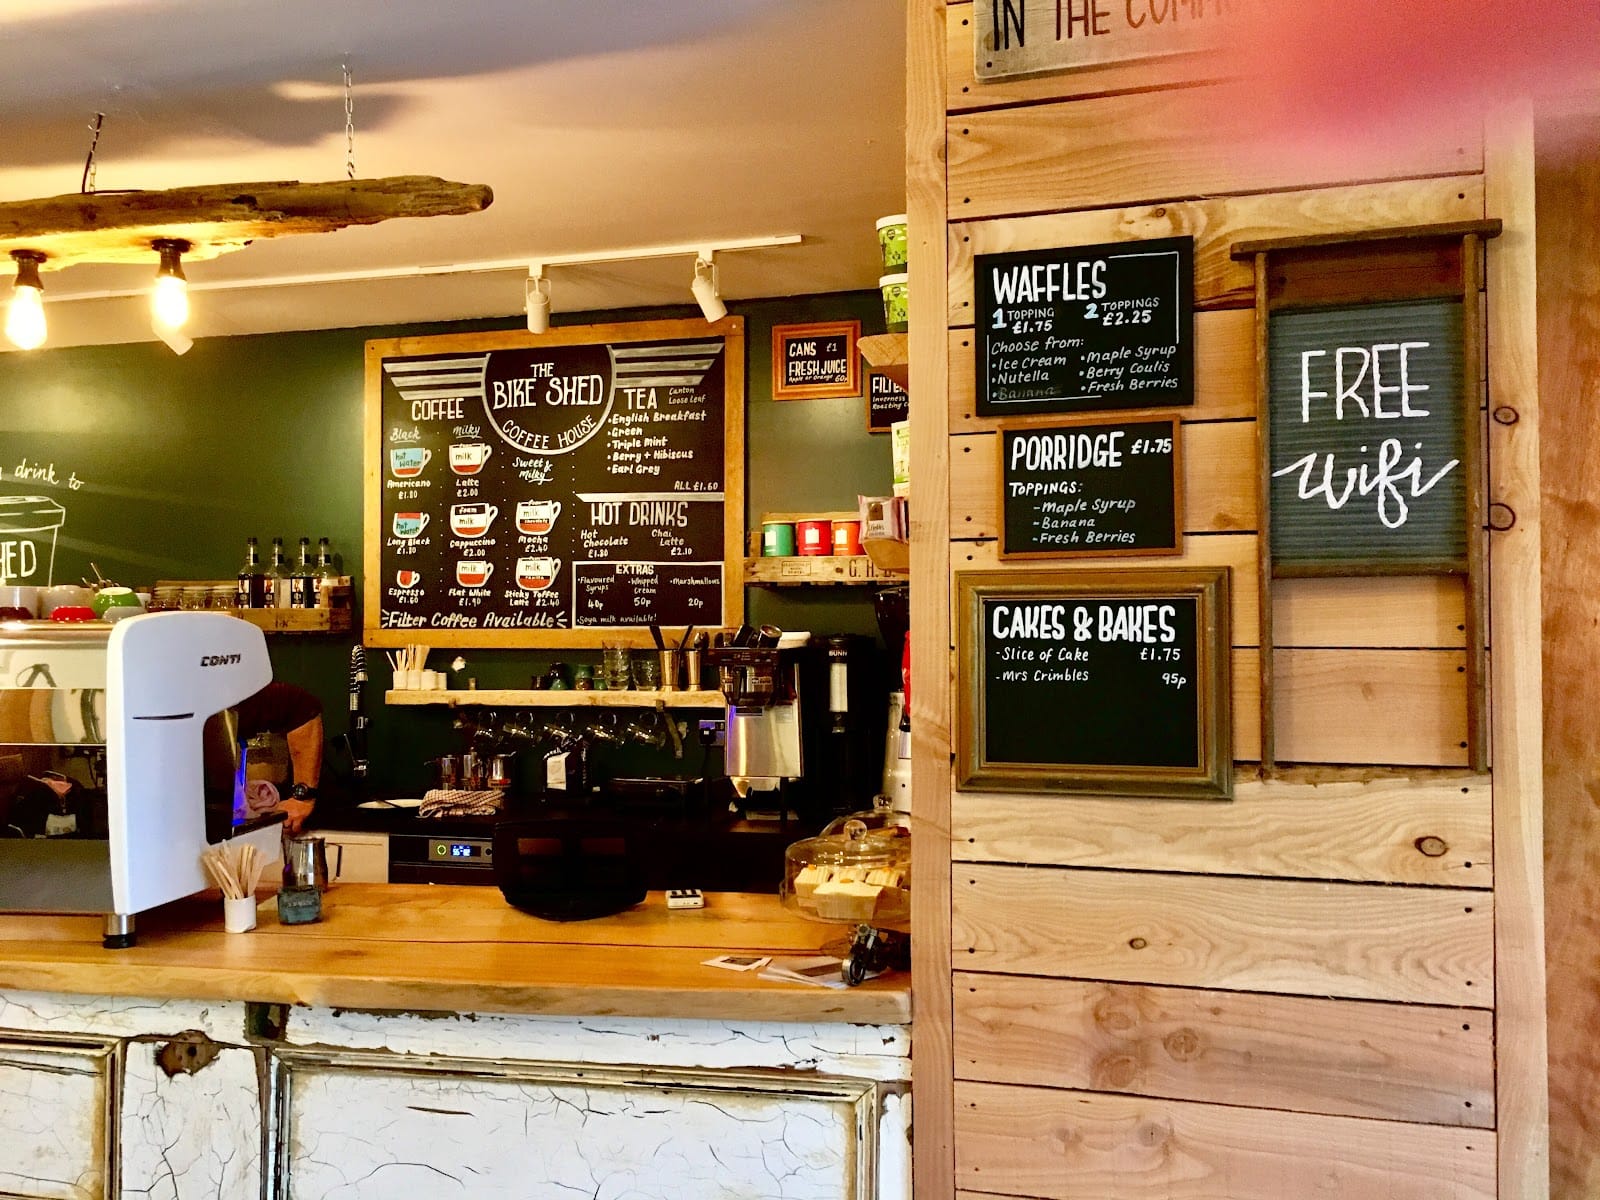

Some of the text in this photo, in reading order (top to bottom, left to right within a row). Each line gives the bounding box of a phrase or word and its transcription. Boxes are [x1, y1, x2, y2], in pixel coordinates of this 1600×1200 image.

[992, 0, 1025, 51] IN
[1055, 0, 1111, 41] THE
[992, 259, 1107, 305] WAFFLES
[1083, 296, 1160, 319] 2 TOPPINGS
[991, 307, 1055, 329] 1 TOPPING
[1102, 310, 1152, 326] £2.25
[1012, 319, 1053, 334] £1.75
[789, 341, 817, 357] CANS
[991, 336, 1084, 355] Choose from:
[1086, 344, 1177, 365] Maple Syrup
[530, 363, 555, 378] THE
[788, 358, 847, 376] FRESH JUICE
[998, 355, 1067, 371] Ice Cream
[1086, 360, 1170, 381] Berry Coulis
[997, 369, 1050, 385] Nutella
[1087, 376, 1178, 393] Fresh Berries
[1301, 341, 1430, 423] FREE
[493, 375, 604, 410] BIKE SHED
[623, 387, 658, 410] TEA
[668, 396, 689, 405] Loose
[412, 398, 464, 421] COFFEE
[612, 410, 707, 426] English Breakfast
[389, 426, 421, 441] Black
[453, 424, 481, 438] Milky
[502, 414, 597, 449] COFFEE HOUSE
[611, 427, 643, 437] Green
[611, 436, 669, 452] Triple Mint
[1011, 431, 1172, 471] PORRIDGE £1.75
[512, 456, 544, 468] Sweet
[612, 452, 641, 464] Berry
[653, 449, 694, 460] Hibiscus
[14, 458, 59, 485] drink
[68, 472, 85, 490] to
[519, 469, 546, 485] Milky
[612, 464, 661, 476] Earl Grey
[387, 478, 431, 489] Americano
[456, 478, 479, 487] Latte
[674, 480, 719, 491] ALL £1.60
[1009, 481, 1084, 497] TOPPINGS:
[590, 501, 689, 527] HOT DRINKS
[1042, 498, 1136, 517] Maple Syrup
[1041, 516, 1095, 530] Banana
[518, 535, 549, 544] Mocha
[580, 529, 598, 539] Hot
[651, 529, 672, 538] Chai
[1039, 529, 1136, 544] Fresh Berries
[387, 536, 431, 548] Long Black
[449, 536, 496, 549] Cappuccino
[525, 544, 548, 554] £2.40
[583, 536, 629, 548] Chocolate
[659, 537, 684, 547] Latte
[463, 548, 486, 557] £2.00
[670, 547, 693, 556] £2.10
[615, 564, 654, 575] EXTRAS
[580, 575, 615, 584] Flavoured
[631, 575, 659, 587] Whipped
[672, 576, 720, 585] Marshmallows
[388, 587, 425, 598] Espresso
[448, 588, 492, 597] Flat White
[504, 589, 559, 600] Sticky Toffee
[585, 584, 609, 594] Syrups
[587, 599, 604, 610] 40p
[633, 597, 652, 607] 50p
[688, 598, 704, 608] 20p
[388, 610, 554, 628] Filter Coffee Available
[579, 615, 598, 625] Soya
[600, 615, 616, 623] milk
[992, 604, 1176, 644] CAKES & BAKES
[200, 653, 241, 667] CONTI
[828, 649, 848, 657] BUNN
[1001, 645, 1089, 663] Slice of Cake
[1140, 647, 1181, 661] £1.75
[1033, 667, 1089, 682] Crimbles
[1162, 672, 1187, 690] 95p
